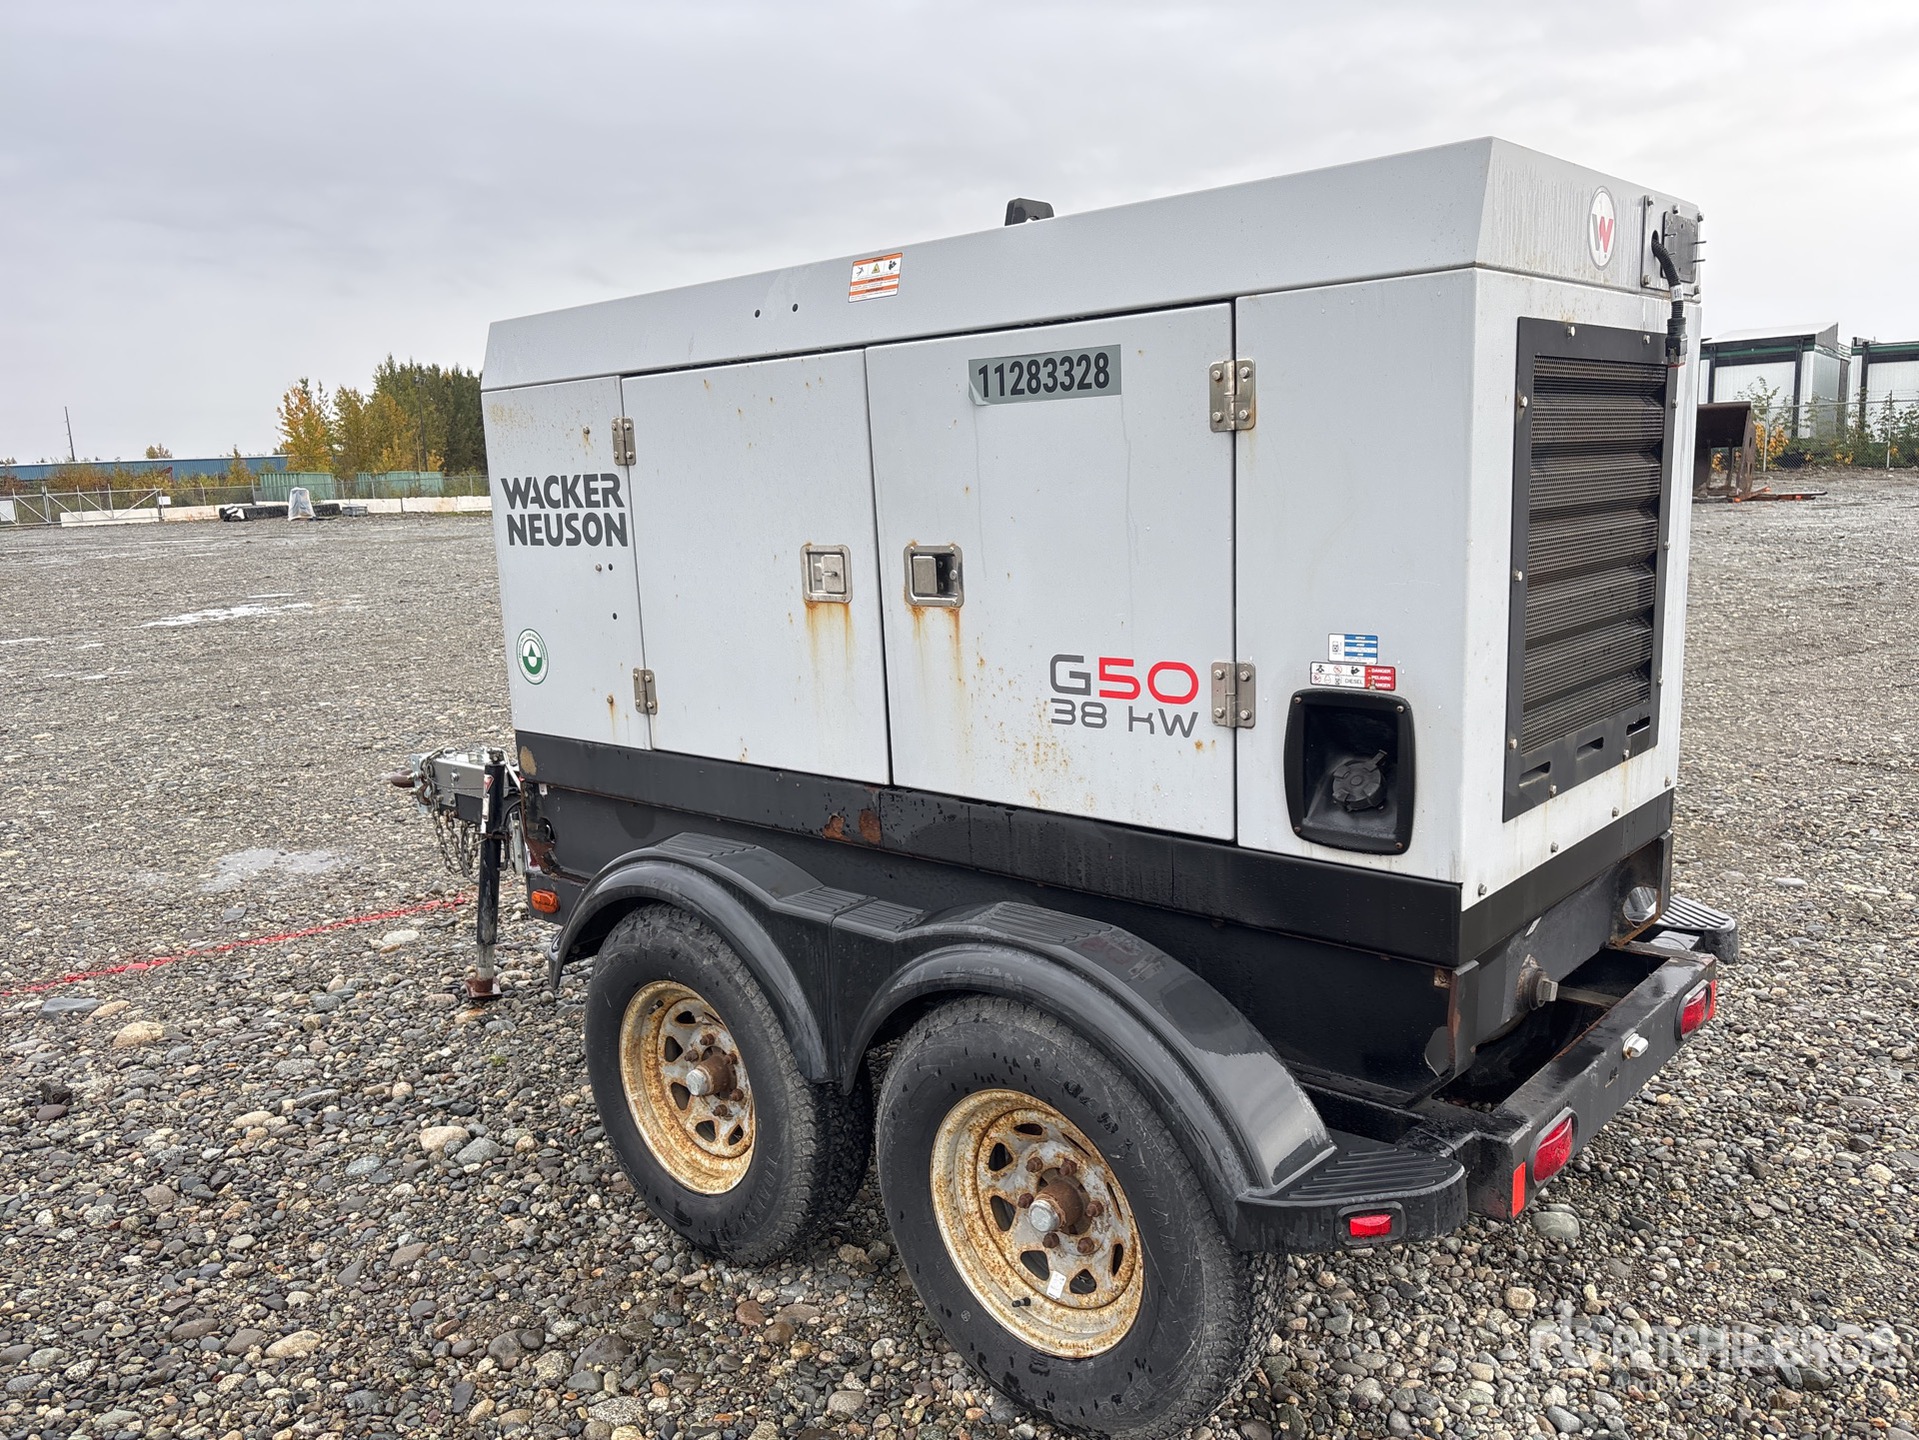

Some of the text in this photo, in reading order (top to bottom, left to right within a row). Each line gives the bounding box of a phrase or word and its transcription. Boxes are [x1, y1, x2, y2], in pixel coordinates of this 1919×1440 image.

[978, 352, 1110, 398] 11283328
[500, 473, 625, 509] WACKER
[506, 512, 629, 547] NEUSON
[1050, 654, 1199, 705] G50
[1051, 698, 1107, 729] 38
